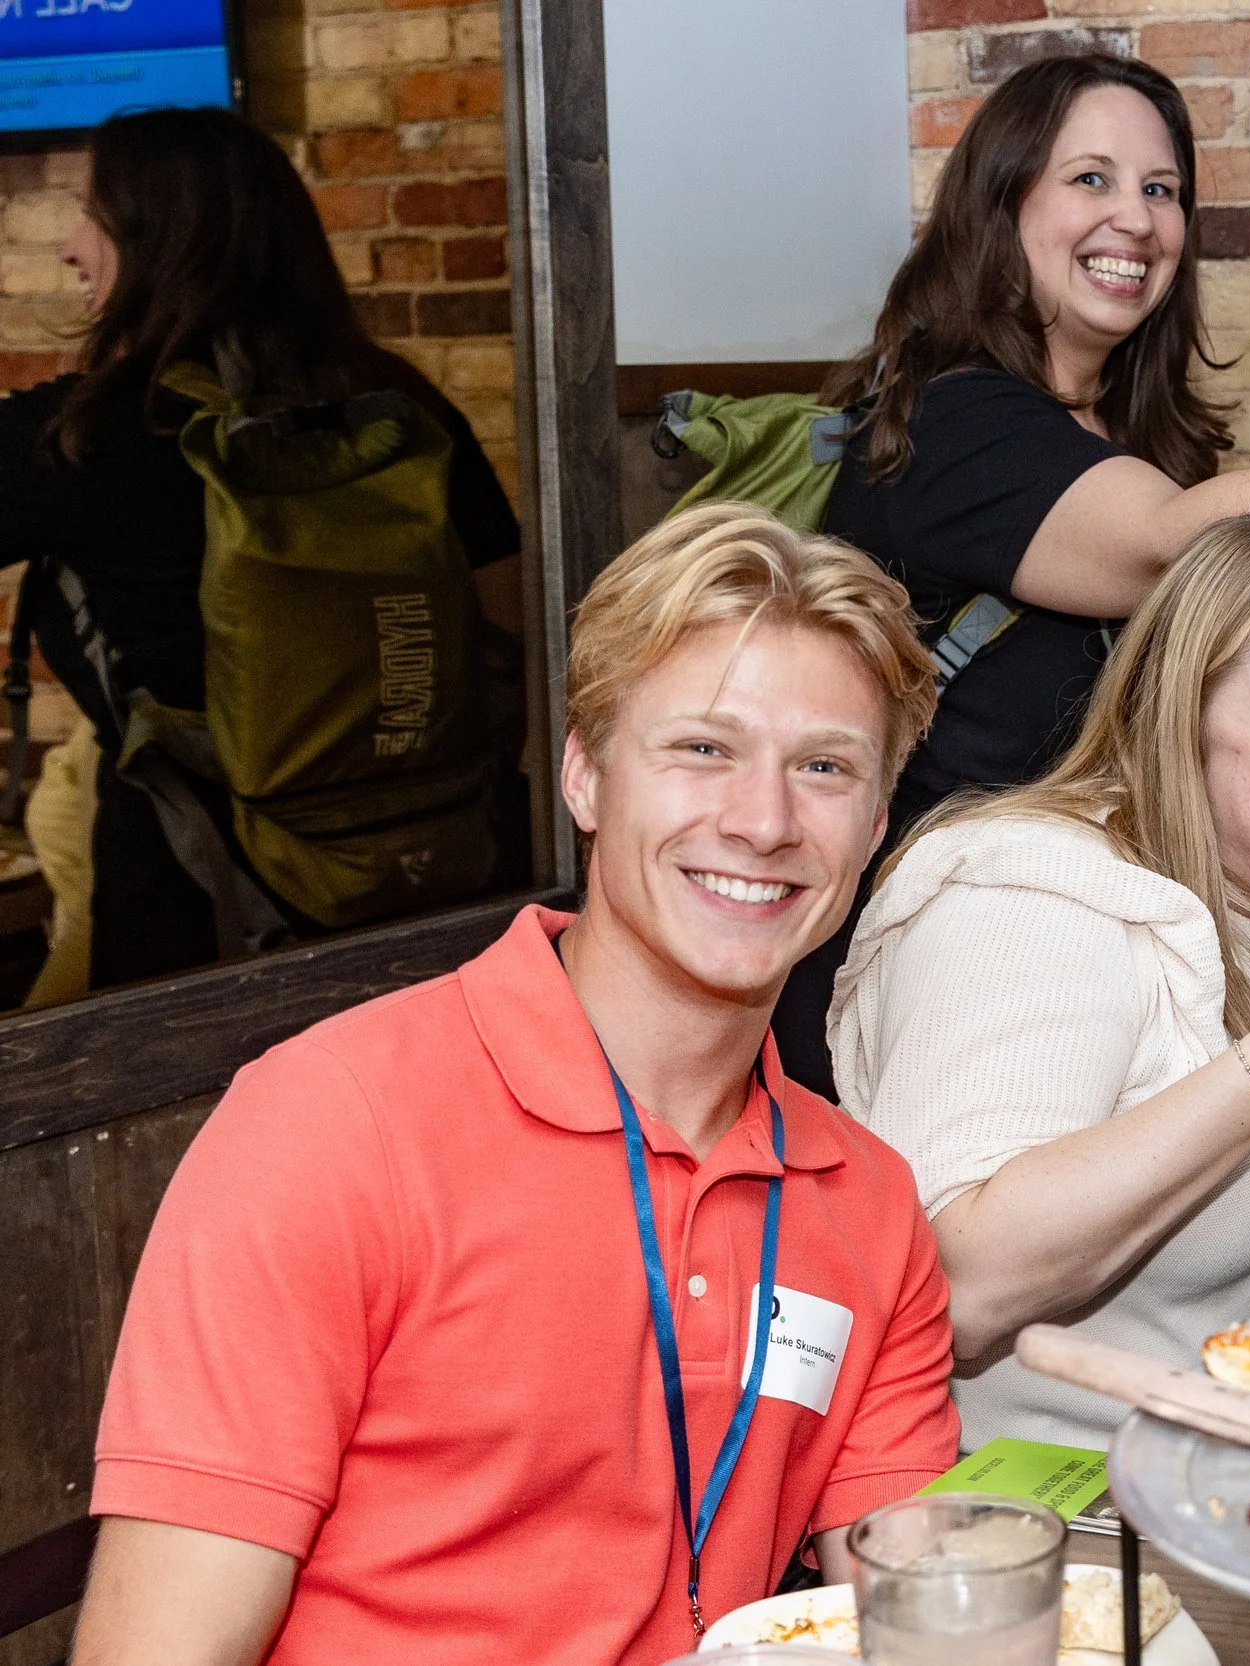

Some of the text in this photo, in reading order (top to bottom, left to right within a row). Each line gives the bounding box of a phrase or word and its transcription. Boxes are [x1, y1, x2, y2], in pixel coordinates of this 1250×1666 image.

[770, 1332, 837, 1363] Luke Skuratowicz
[799, 1355, 817, 1368] Intern
